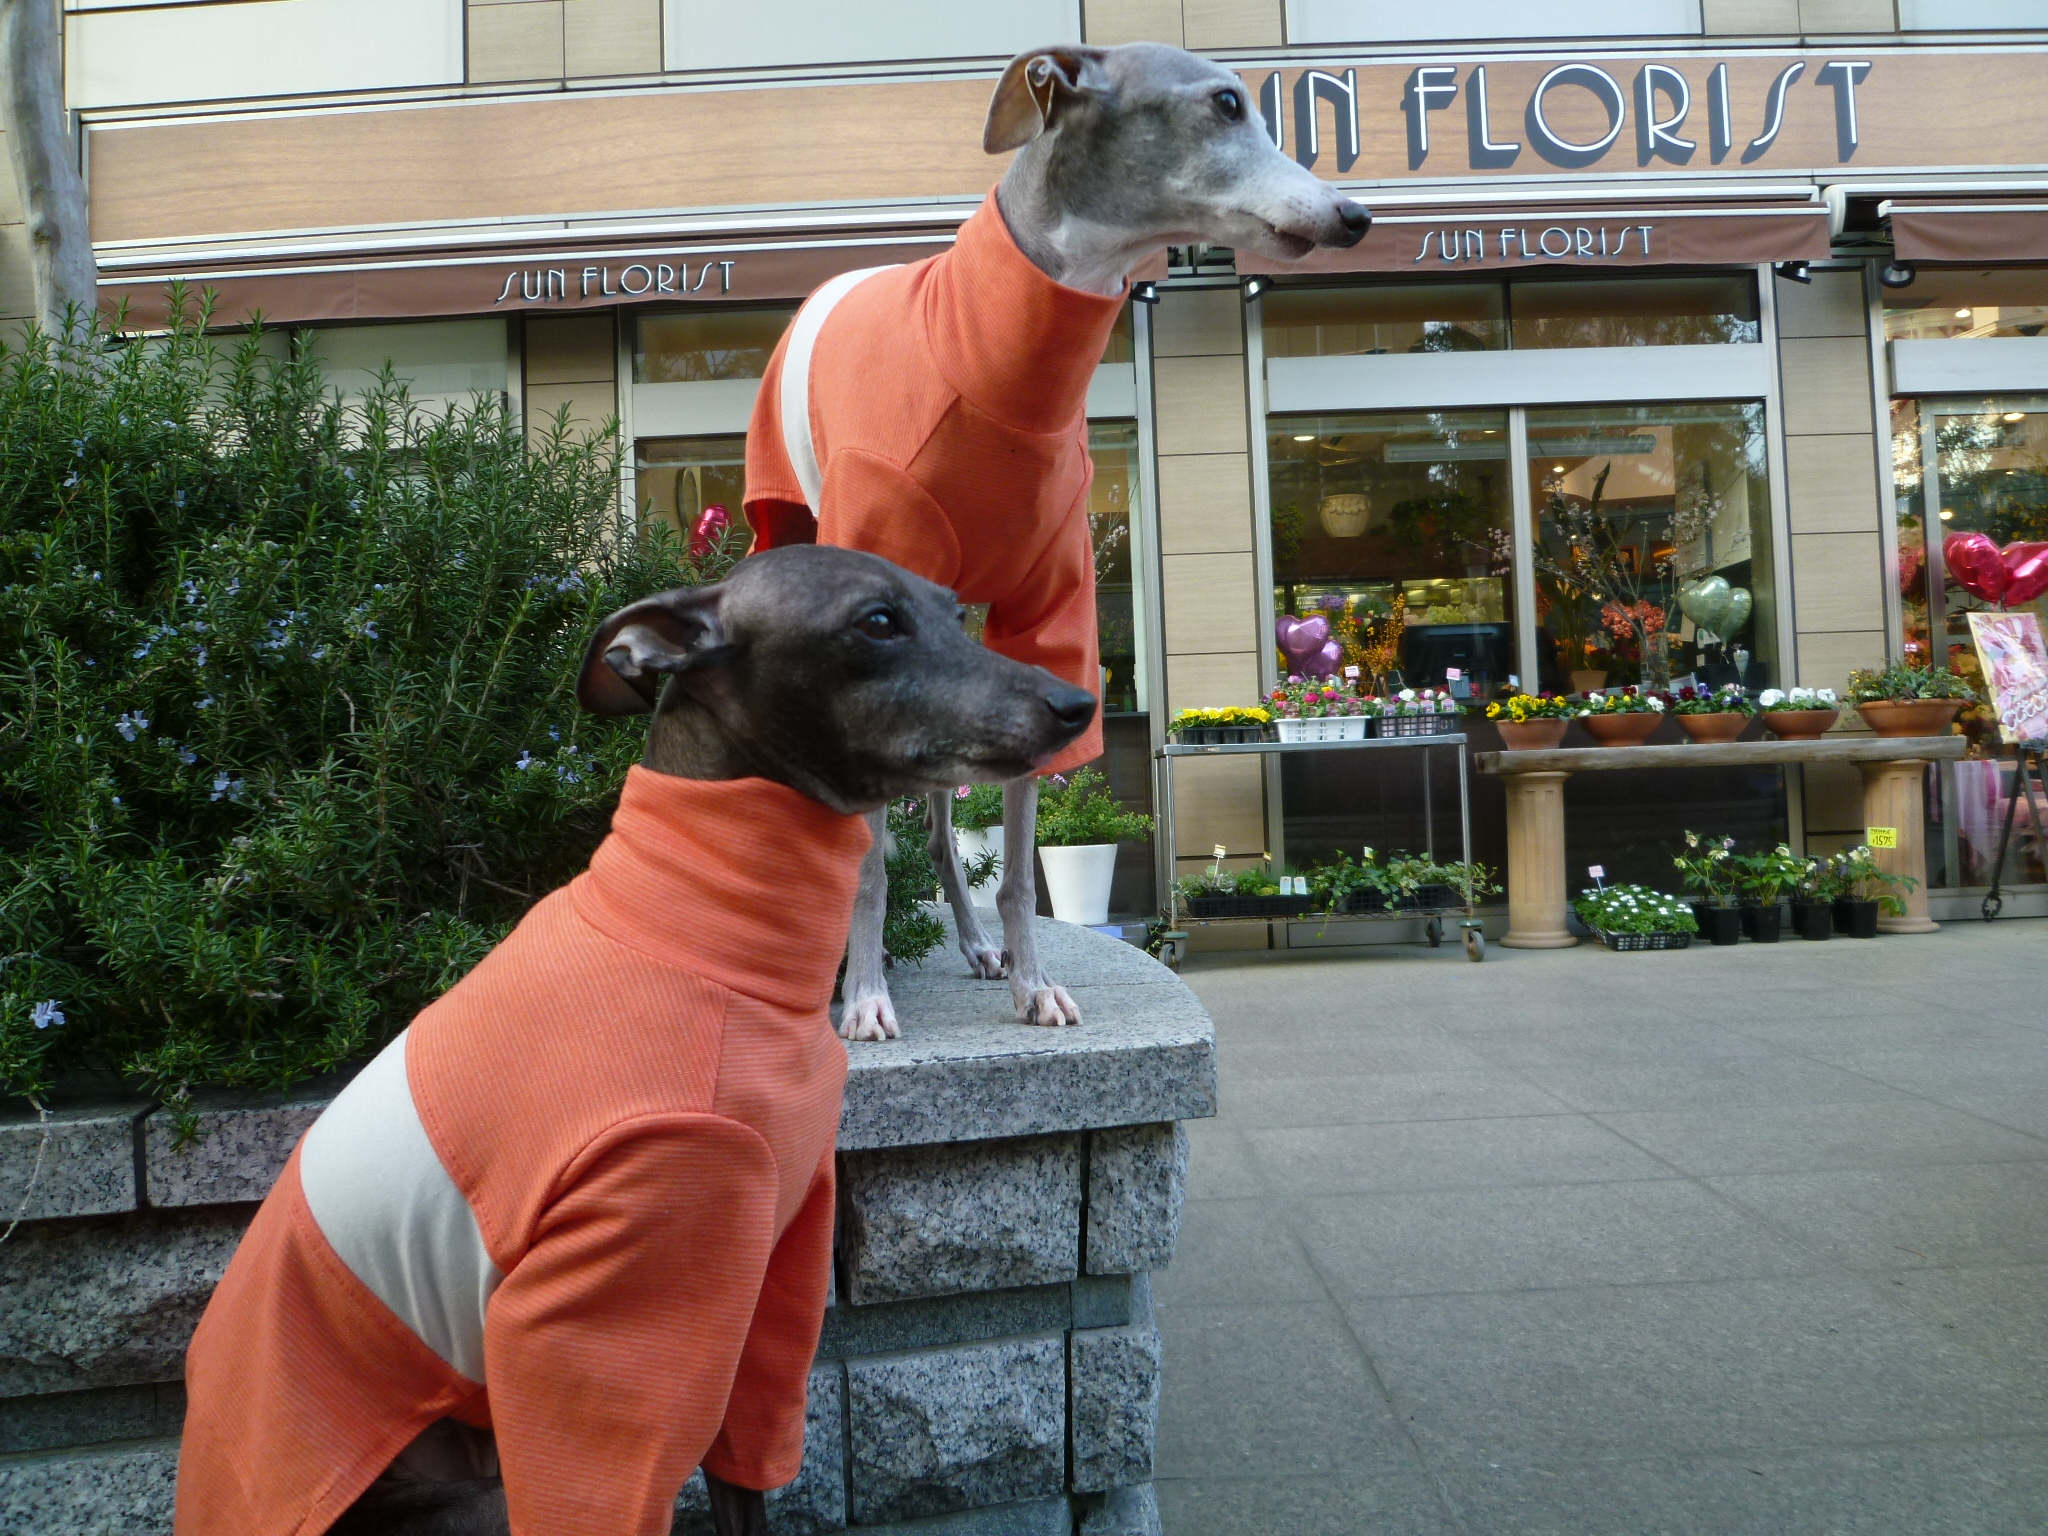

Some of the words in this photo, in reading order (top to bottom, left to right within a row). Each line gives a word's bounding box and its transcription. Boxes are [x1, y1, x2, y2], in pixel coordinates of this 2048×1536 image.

[1234, 66, 1358, 172] UN
[1404, 60, 1872, 169] FLORIST
[1416, 230, 1484, 262] SUN
[1500, 226, 1653, 258] FLORIST
[496, 269, 566, 302] SUN
[581, 261, 735, 297] FLORIST
